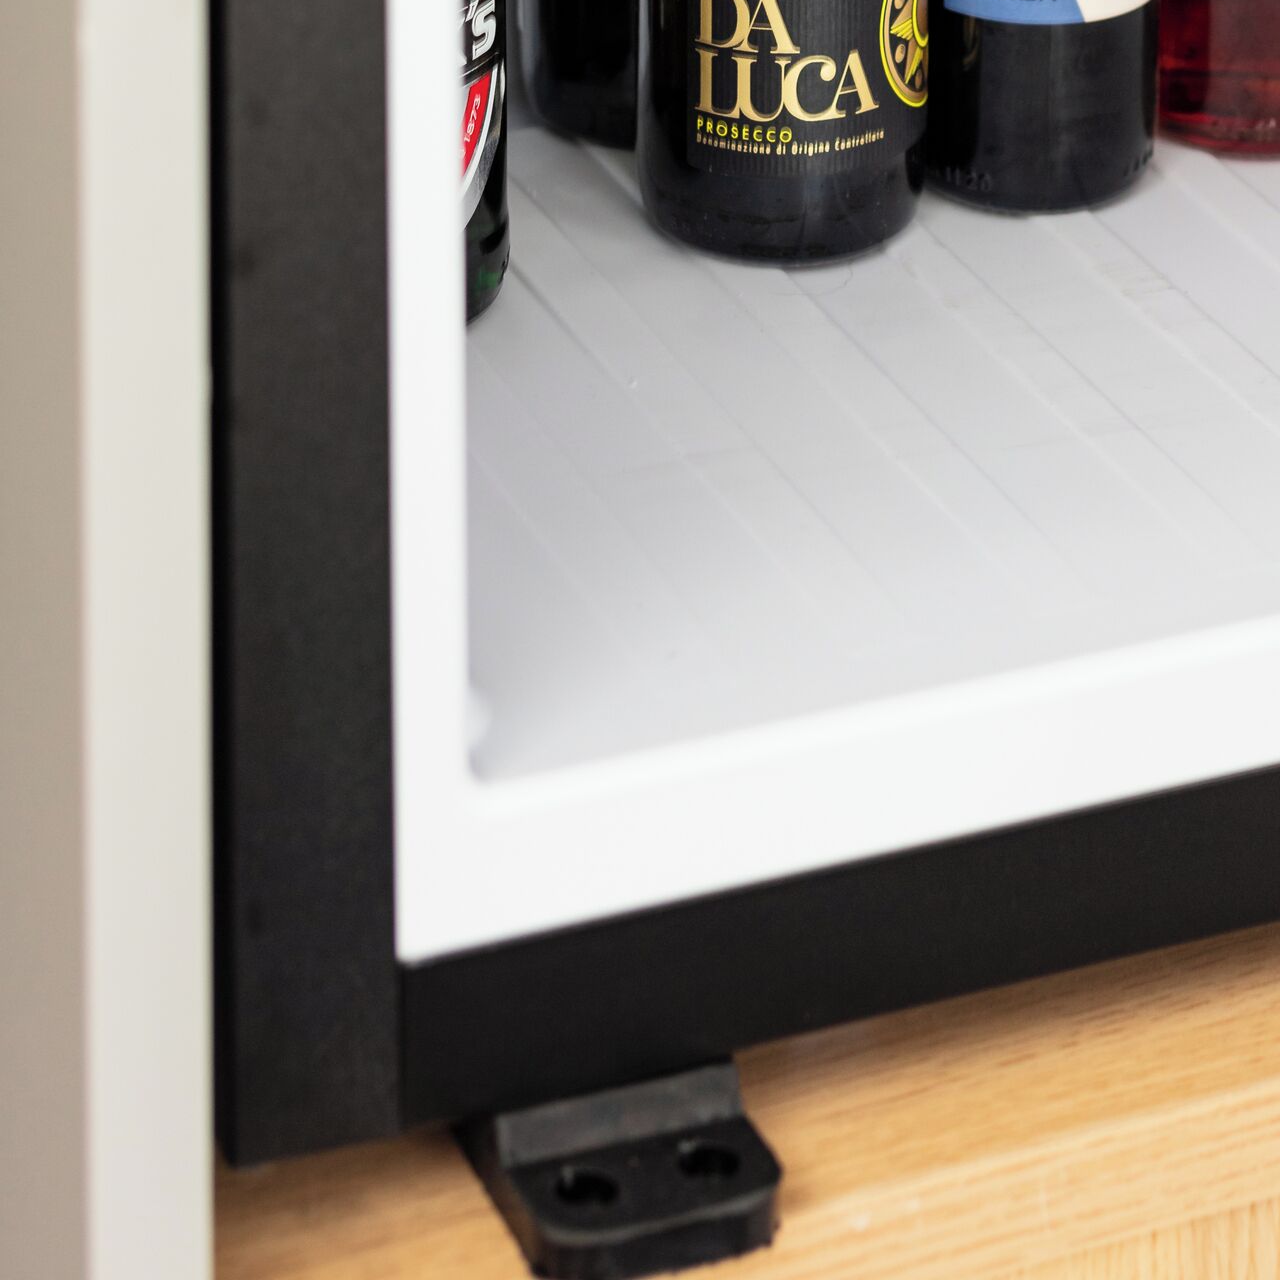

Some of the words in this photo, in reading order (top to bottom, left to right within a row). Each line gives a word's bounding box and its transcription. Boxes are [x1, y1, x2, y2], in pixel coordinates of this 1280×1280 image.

[695, 47, 880, 123] LUCA
[696, 116, 793, 144] PROSECCO
[696, 134, 772, 156] Denominazione
[775, 140, 787, 156] di
[791, 141, 830, 157] Origine
